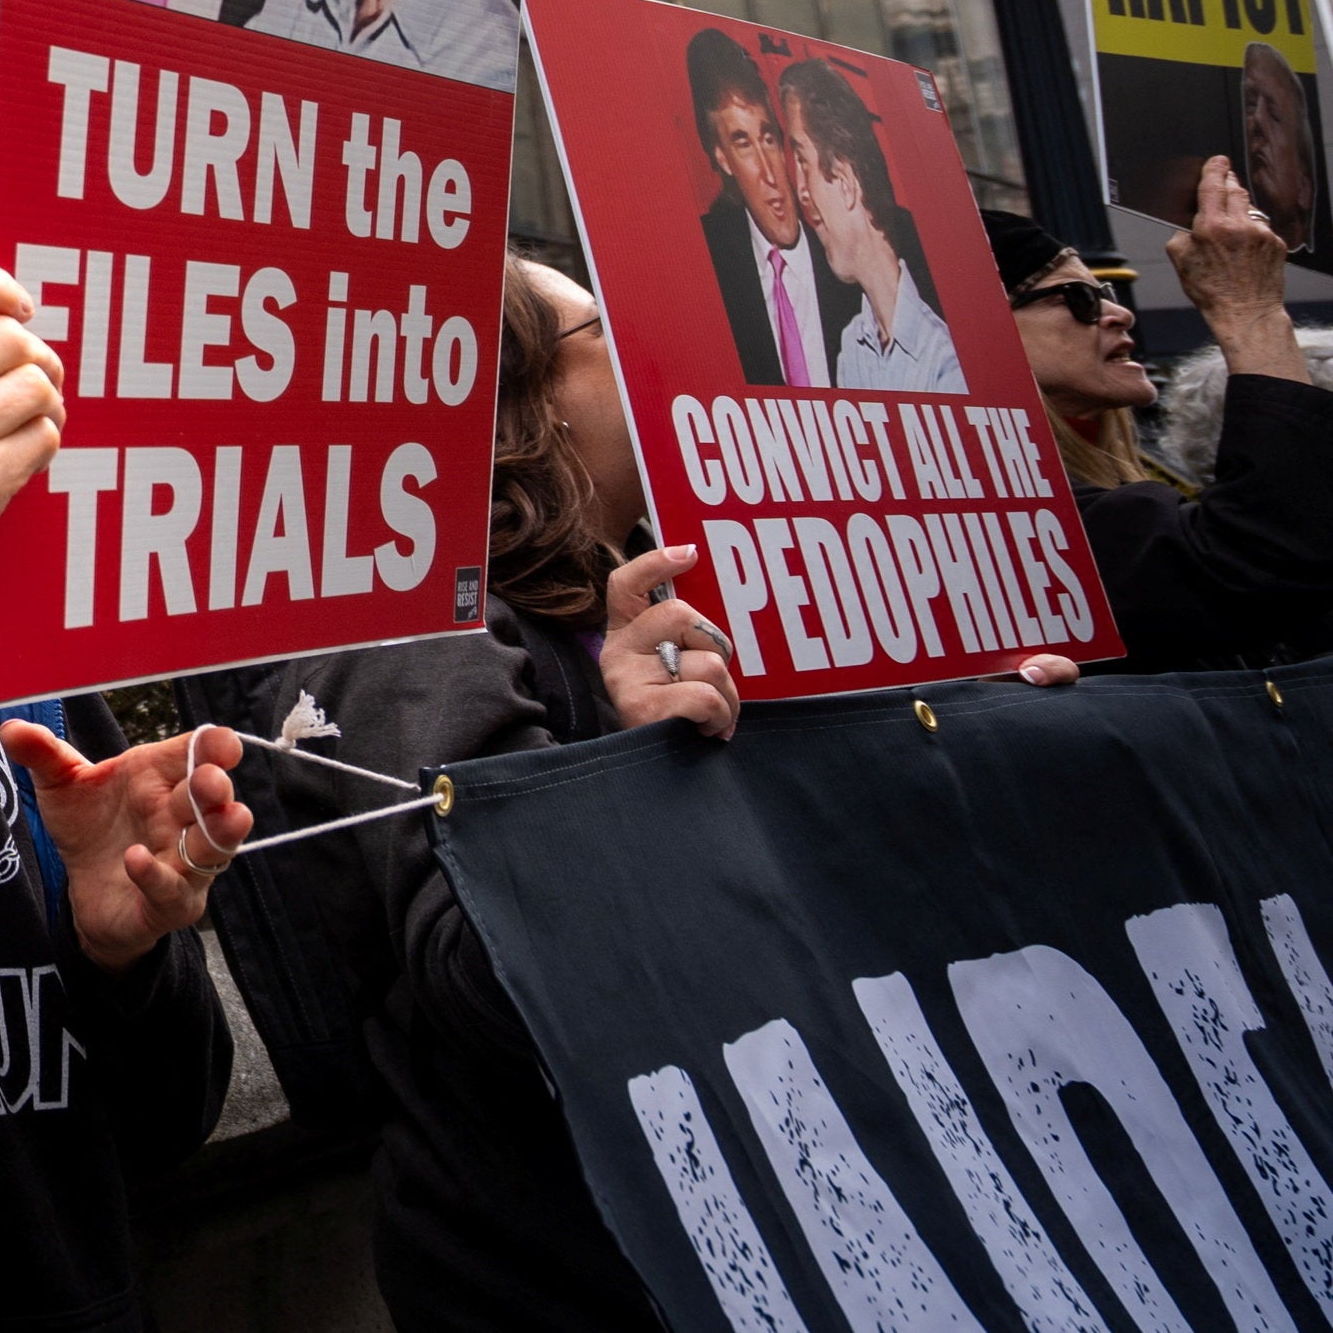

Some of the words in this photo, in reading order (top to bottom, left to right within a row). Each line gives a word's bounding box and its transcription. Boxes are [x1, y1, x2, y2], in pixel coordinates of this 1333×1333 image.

[47, 45, 319, 229] TURN
[342, 113, 473, 250] the
[14, 243, 298, 404] FILES
[321, 271, 479, 407] into
[671, 394, 907, 506] CONVICT
[898, 403, 982, 500] ALL
[966, 406, 1055, 499] THE
[47, 442, 438, 630] TRIALS
[702, 508, 1094, 678] PEDOPHILES
